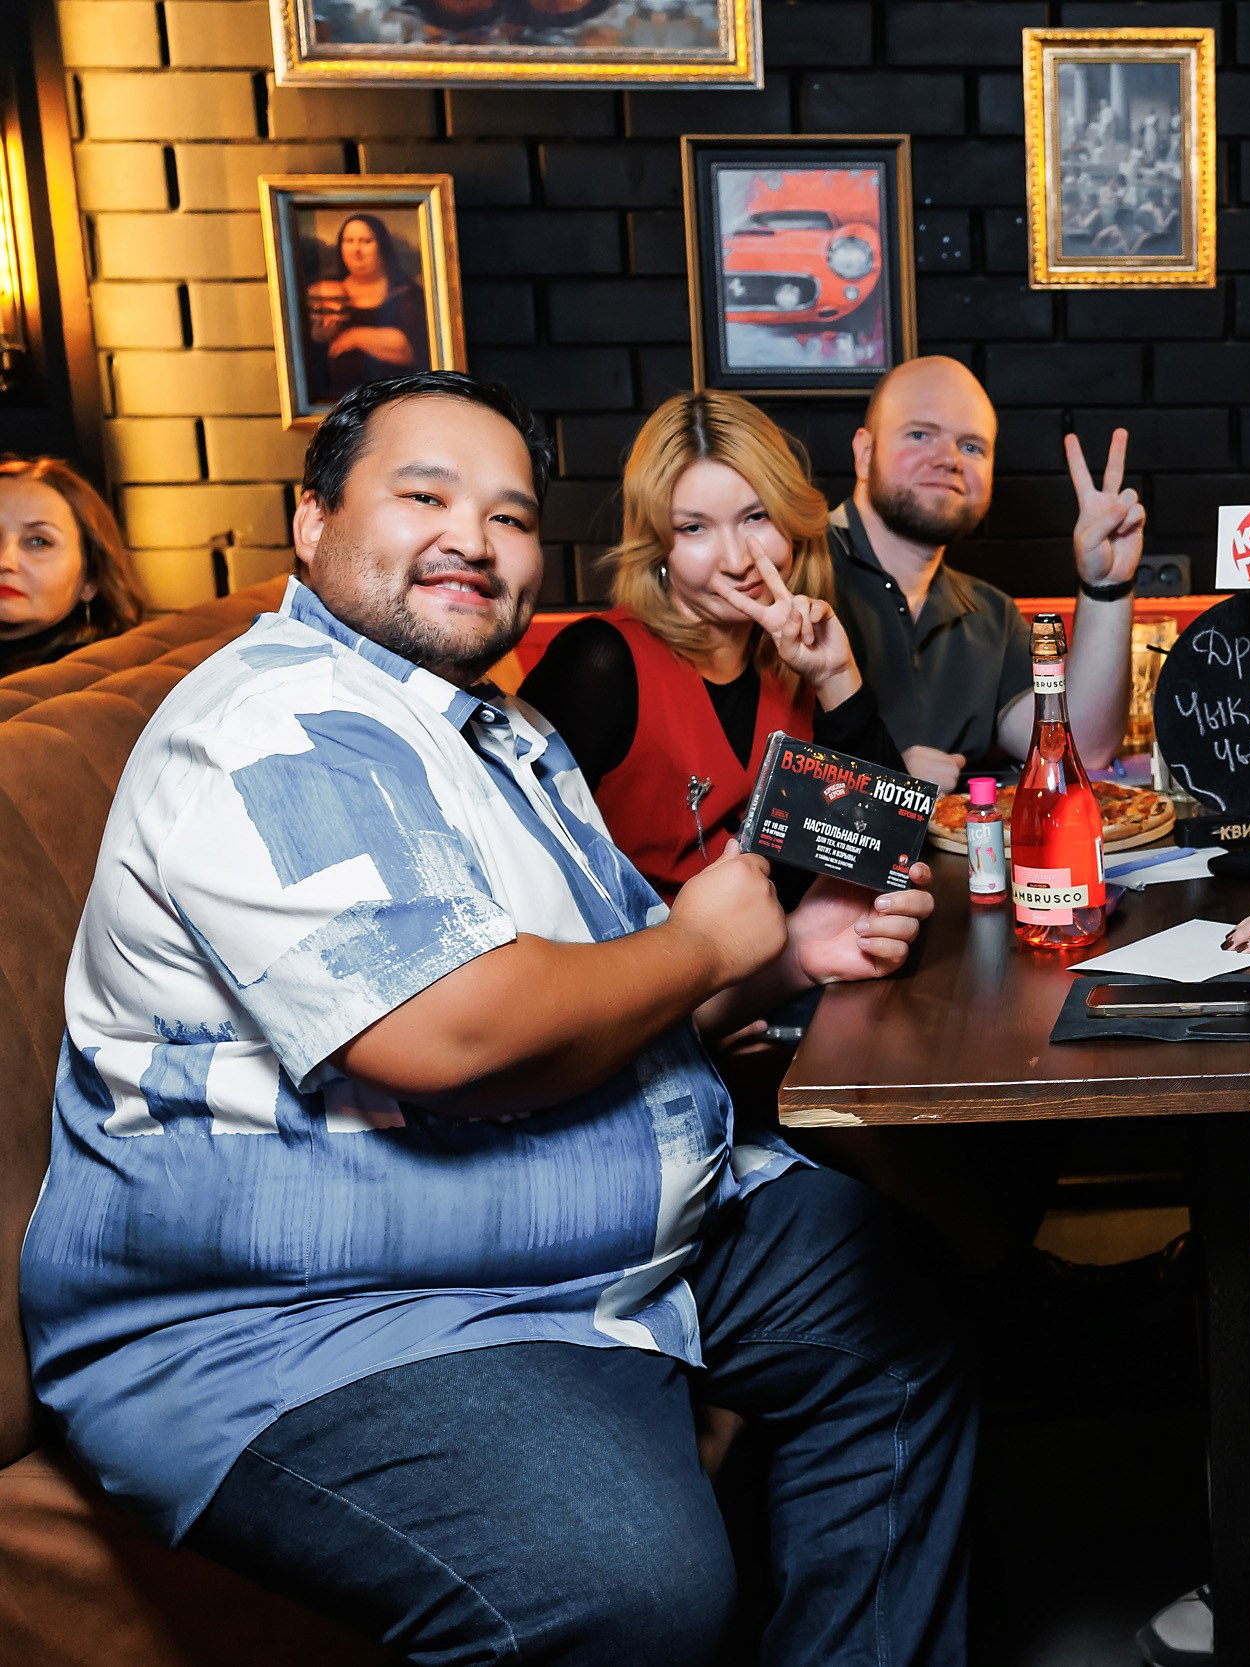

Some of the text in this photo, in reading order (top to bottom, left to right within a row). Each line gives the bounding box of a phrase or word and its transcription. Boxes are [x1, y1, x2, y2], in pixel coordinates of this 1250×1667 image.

[781, 750, 871, 795] ВЗРЫВНЫЕ
[873, 780, 931, 815] КОТЯТА
[803, 817, 860, 846] НАСТОЛЬНАЯ
[859, 833, 882, 851] ИГРА
[1012, 890, 1082, 904] AMBRUSCO
